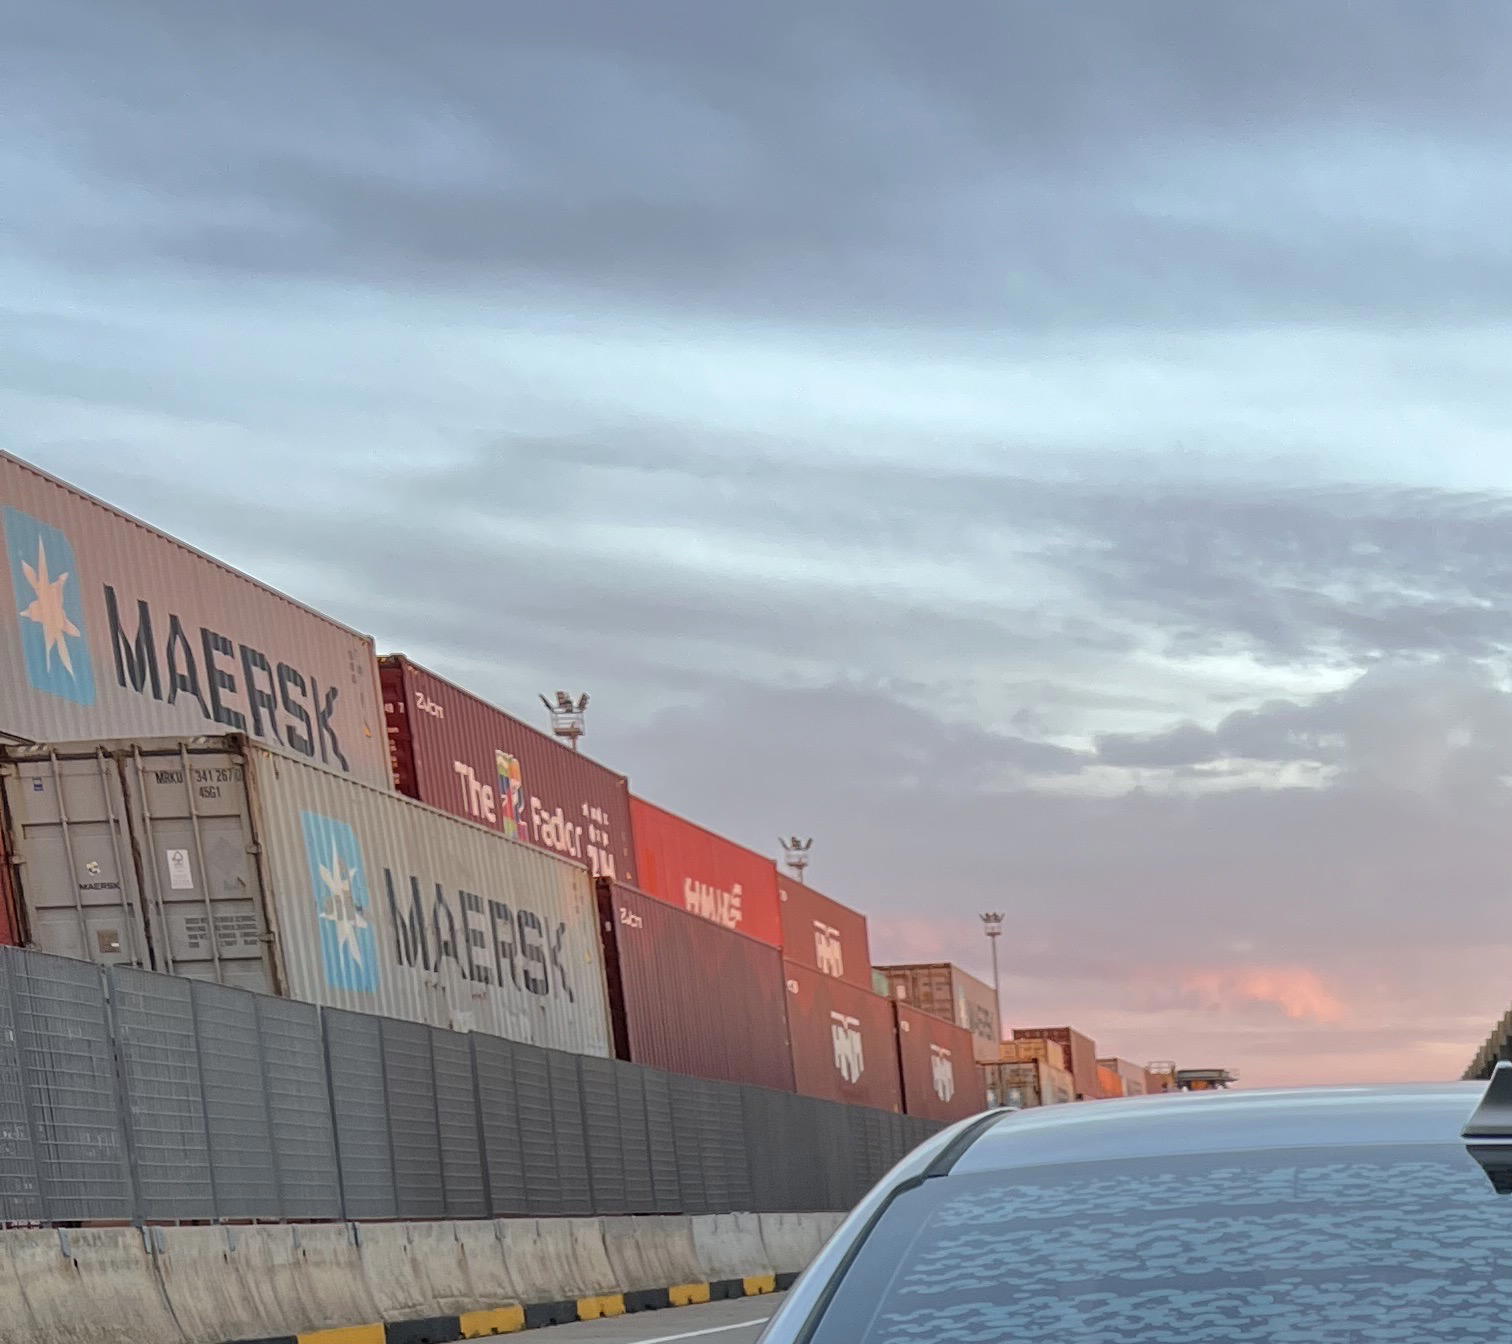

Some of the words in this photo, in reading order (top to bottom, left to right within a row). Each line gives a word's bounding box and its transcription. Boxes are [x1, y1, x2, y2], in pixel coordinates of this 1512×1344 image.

[103, 583, 350, 772] MAERSK
[454, 760, 497, 824] The
[383, 867, 575, 1003] MAERSK
